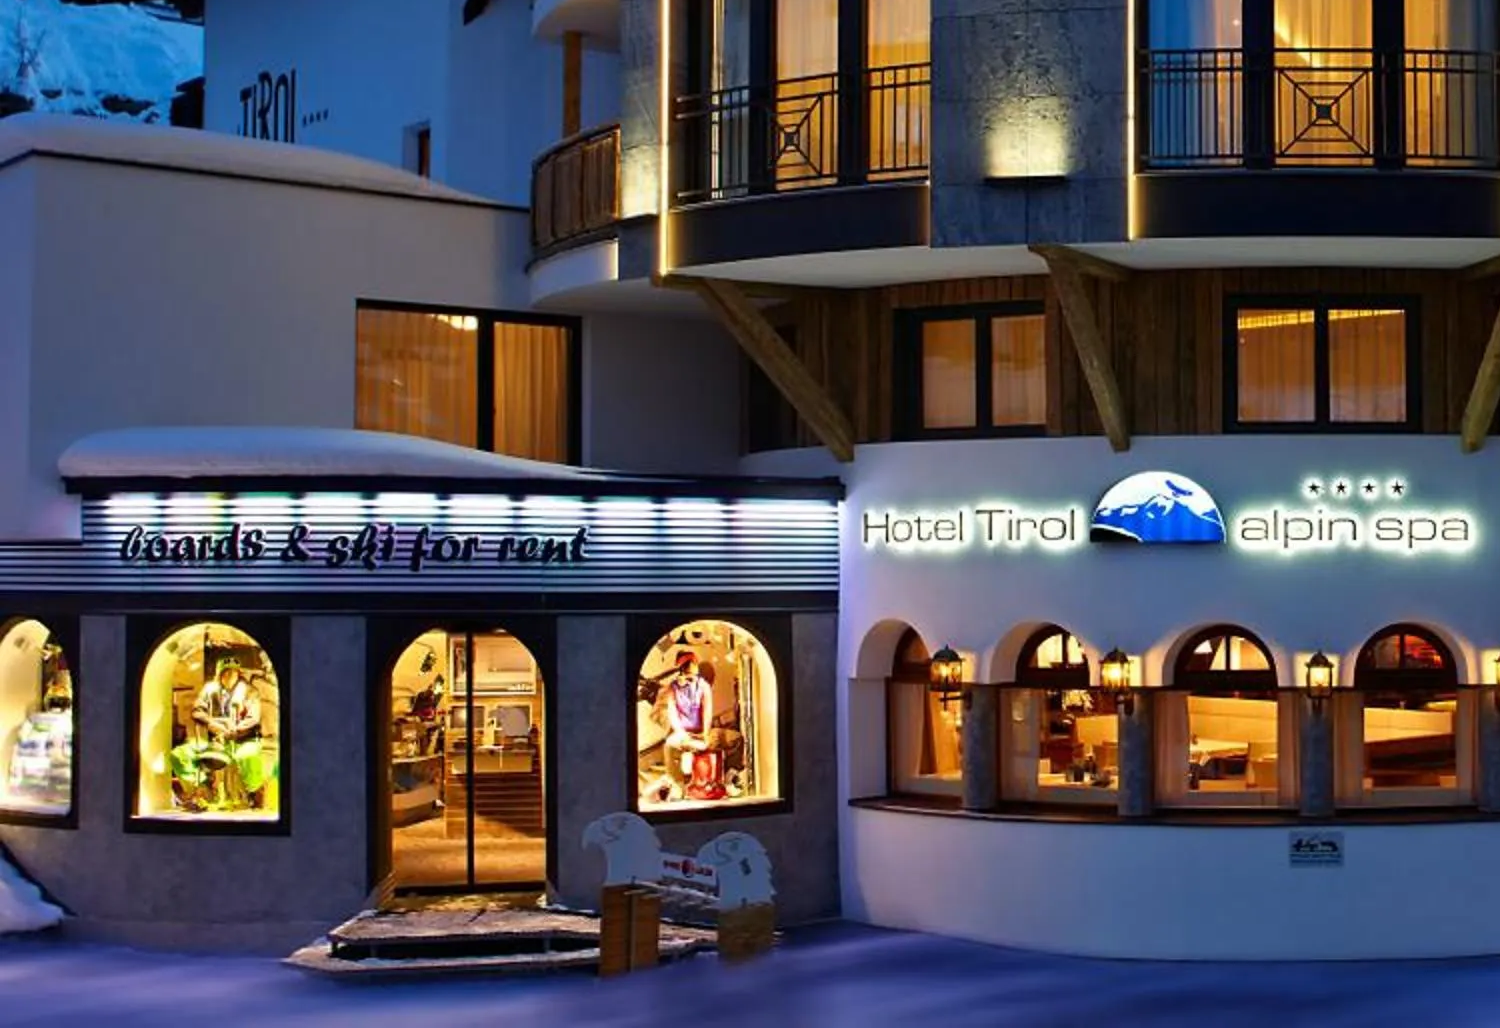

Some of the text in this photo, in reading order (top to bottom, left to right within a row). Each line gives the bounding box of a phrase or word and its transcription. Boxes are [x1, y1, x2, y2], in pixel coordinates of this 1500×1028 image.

[863, 508, 1075, 543] Hotel Tirol
[1241, 509, 1469, 549] alpin spa
[120, 521, 590, 572] boards & ski for rent
